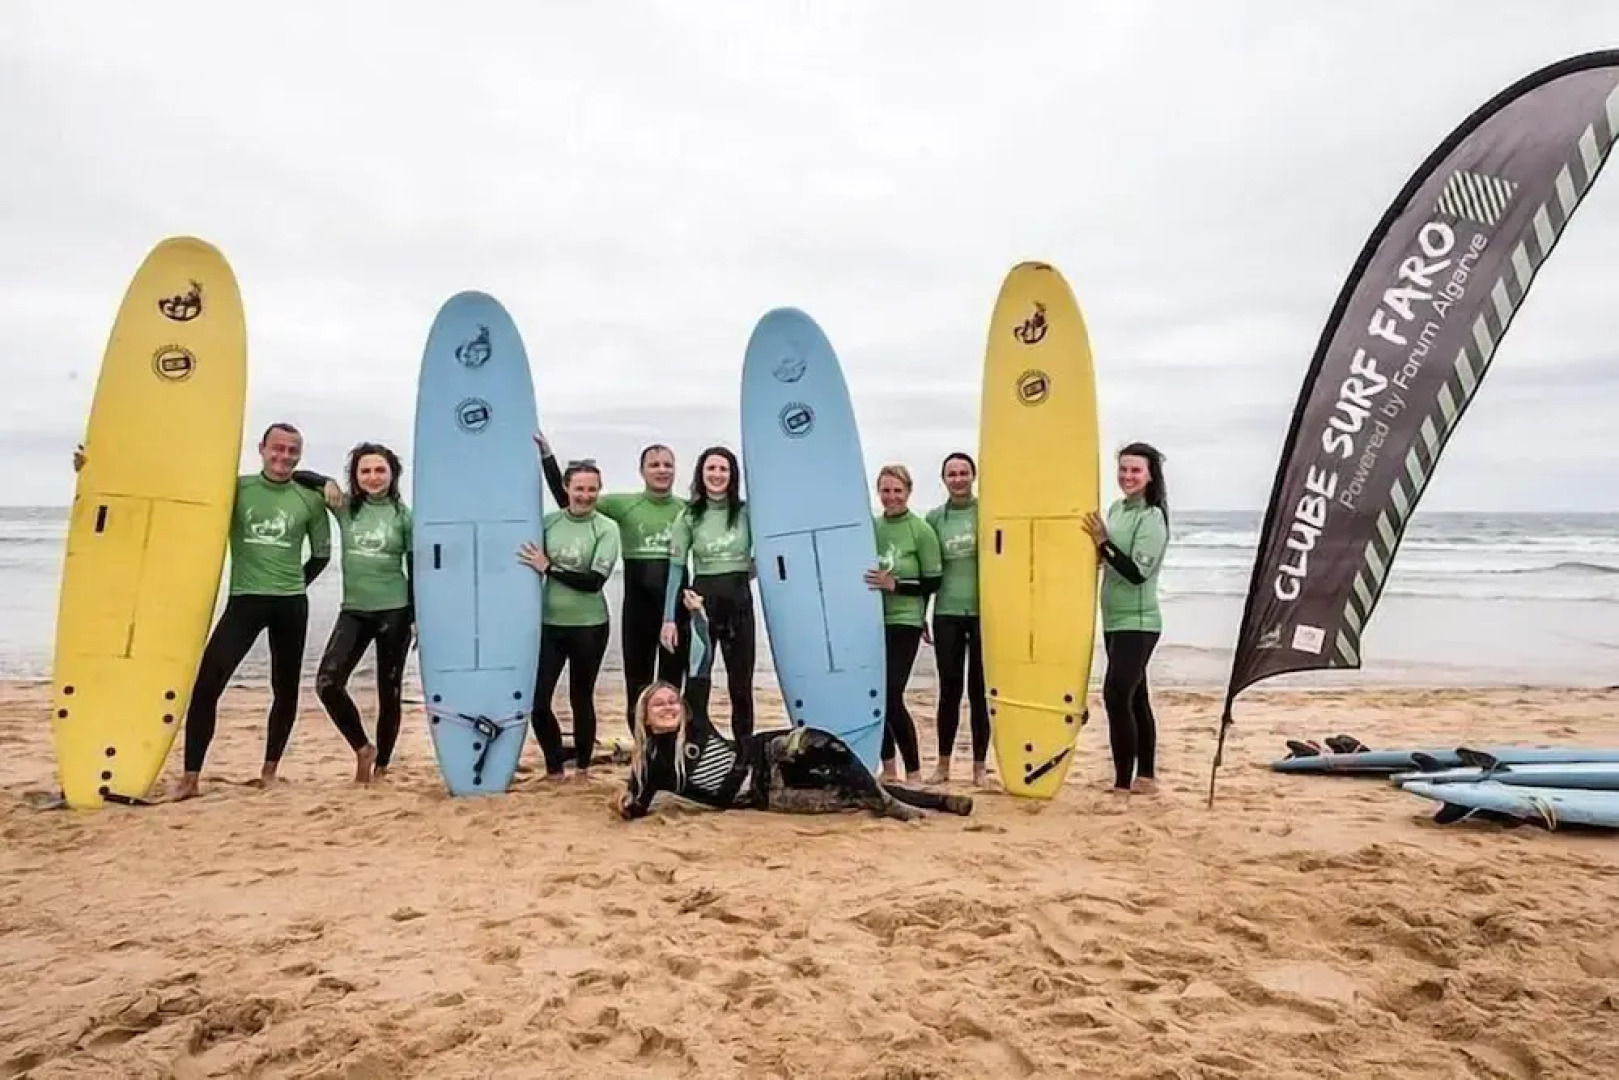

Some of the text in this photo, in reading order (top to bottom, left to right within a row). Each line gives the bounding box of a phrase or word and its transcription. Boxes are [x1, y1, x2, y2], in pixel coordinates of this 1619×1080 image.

[1273, 464, 1339, 602] CLUBE
[1322, 347, 1389, 459] SURF
[1367, 221, 1455, 346] FARO
[1340, 232, 1488, 510] Powered by Forum Algarve
